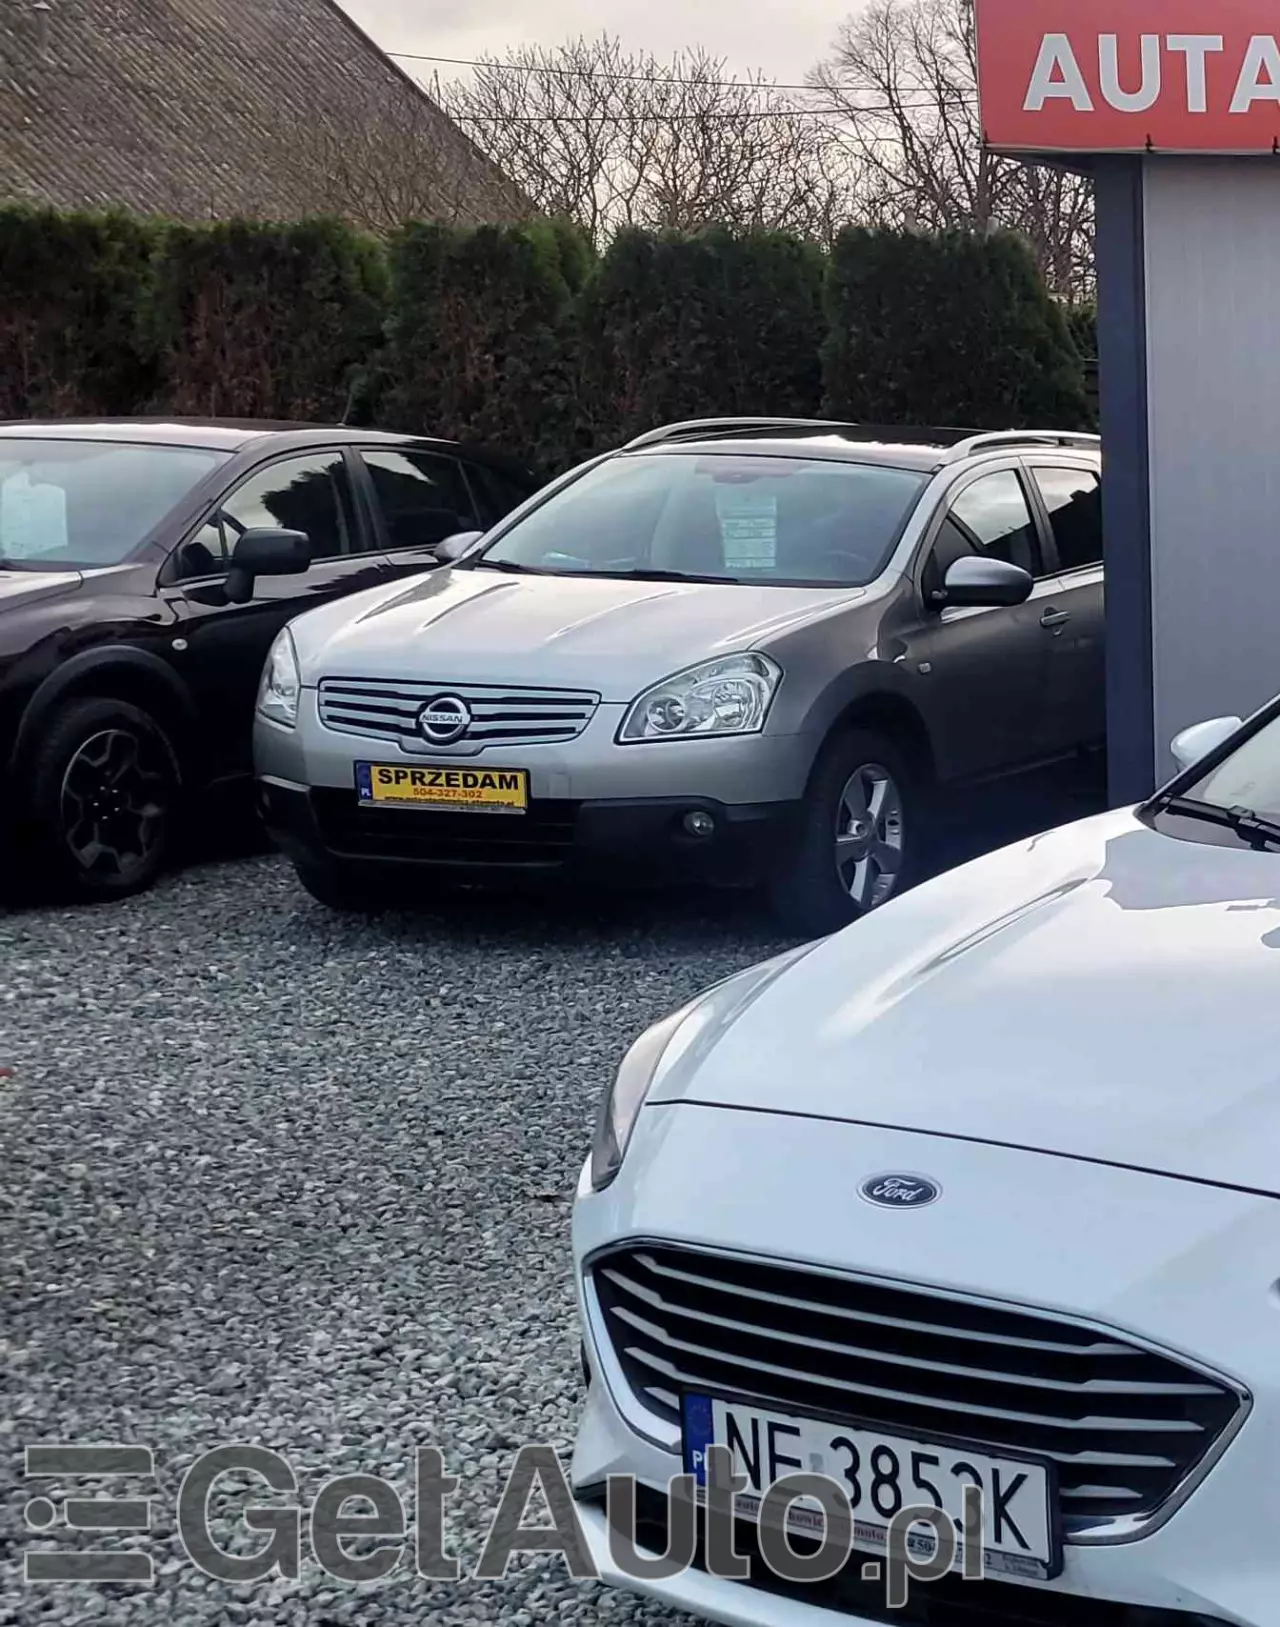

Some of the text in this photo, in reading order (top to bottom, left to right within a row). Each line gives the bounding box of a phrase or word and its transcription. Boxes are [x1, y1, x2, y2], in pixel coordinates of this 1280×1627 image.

[421, 713, 463, 723] NISSAN
[377, 768, 519, 790] SPRZEDAM
[873, 1177, 924, 1201] Ford
